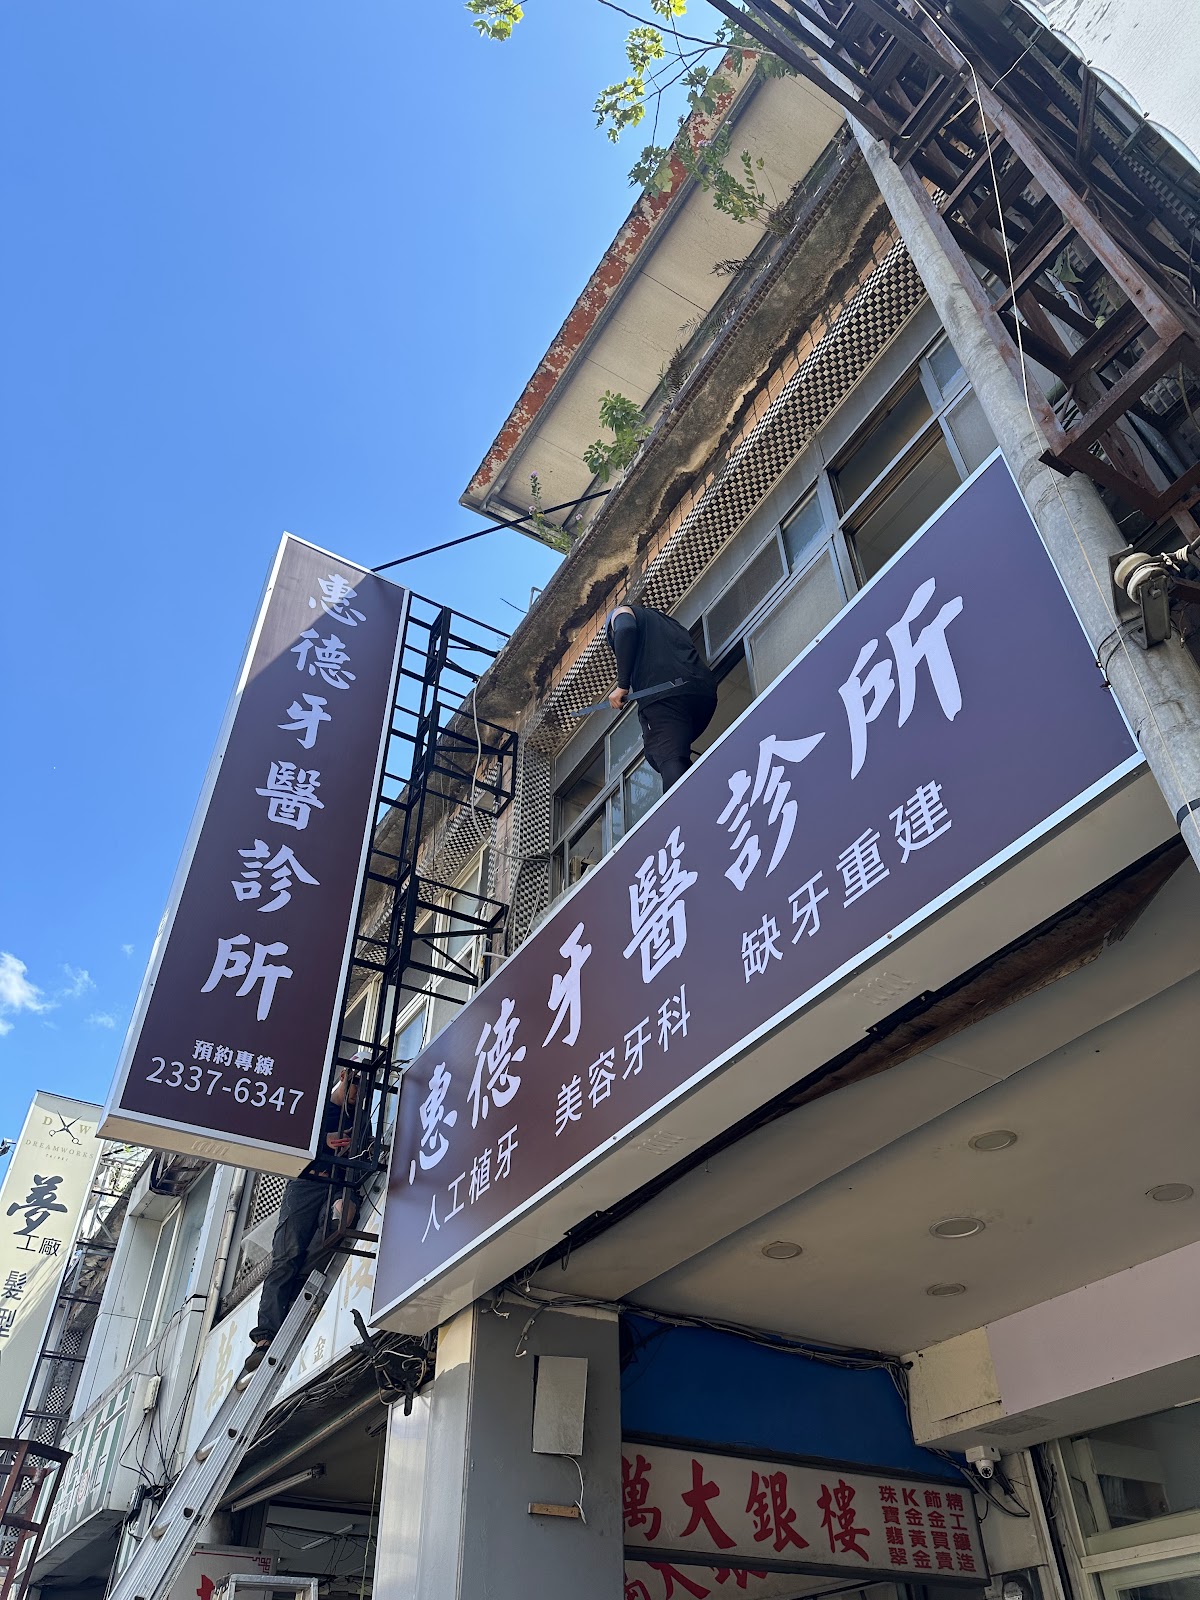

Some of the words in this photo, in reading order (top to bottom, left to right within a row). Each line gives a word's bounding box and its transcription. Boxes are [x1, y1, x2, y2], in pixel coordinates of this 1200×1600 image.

[201, 572, 366, 1022] 惠德牙醫診所
[409, 577, 964, 1185] 惠德牙醫診所
[421, 1124, 519, 1243] 人工植牙
[555, 983, 691, 1137] 美容牙科
[741, 780, 952, 984] 缺牙重建
[146, 1056, 305, 1115] 2337-6347
[192, 1039, 275, 1076] 預約專線
[25, 1139, 95, 1159] DREAMWORKS
[42, 1116, 53, 1126] D
[79, 1124, 92, 1135] W
[622, 1454, 870, 1562] 萬大銀樓
[878, 1485, 908, 1566] 珠寶翡翠
[923, 1489, 954, 1571] 飾金買賣
[945, 1492, 977, 1572] 精工鑲造
